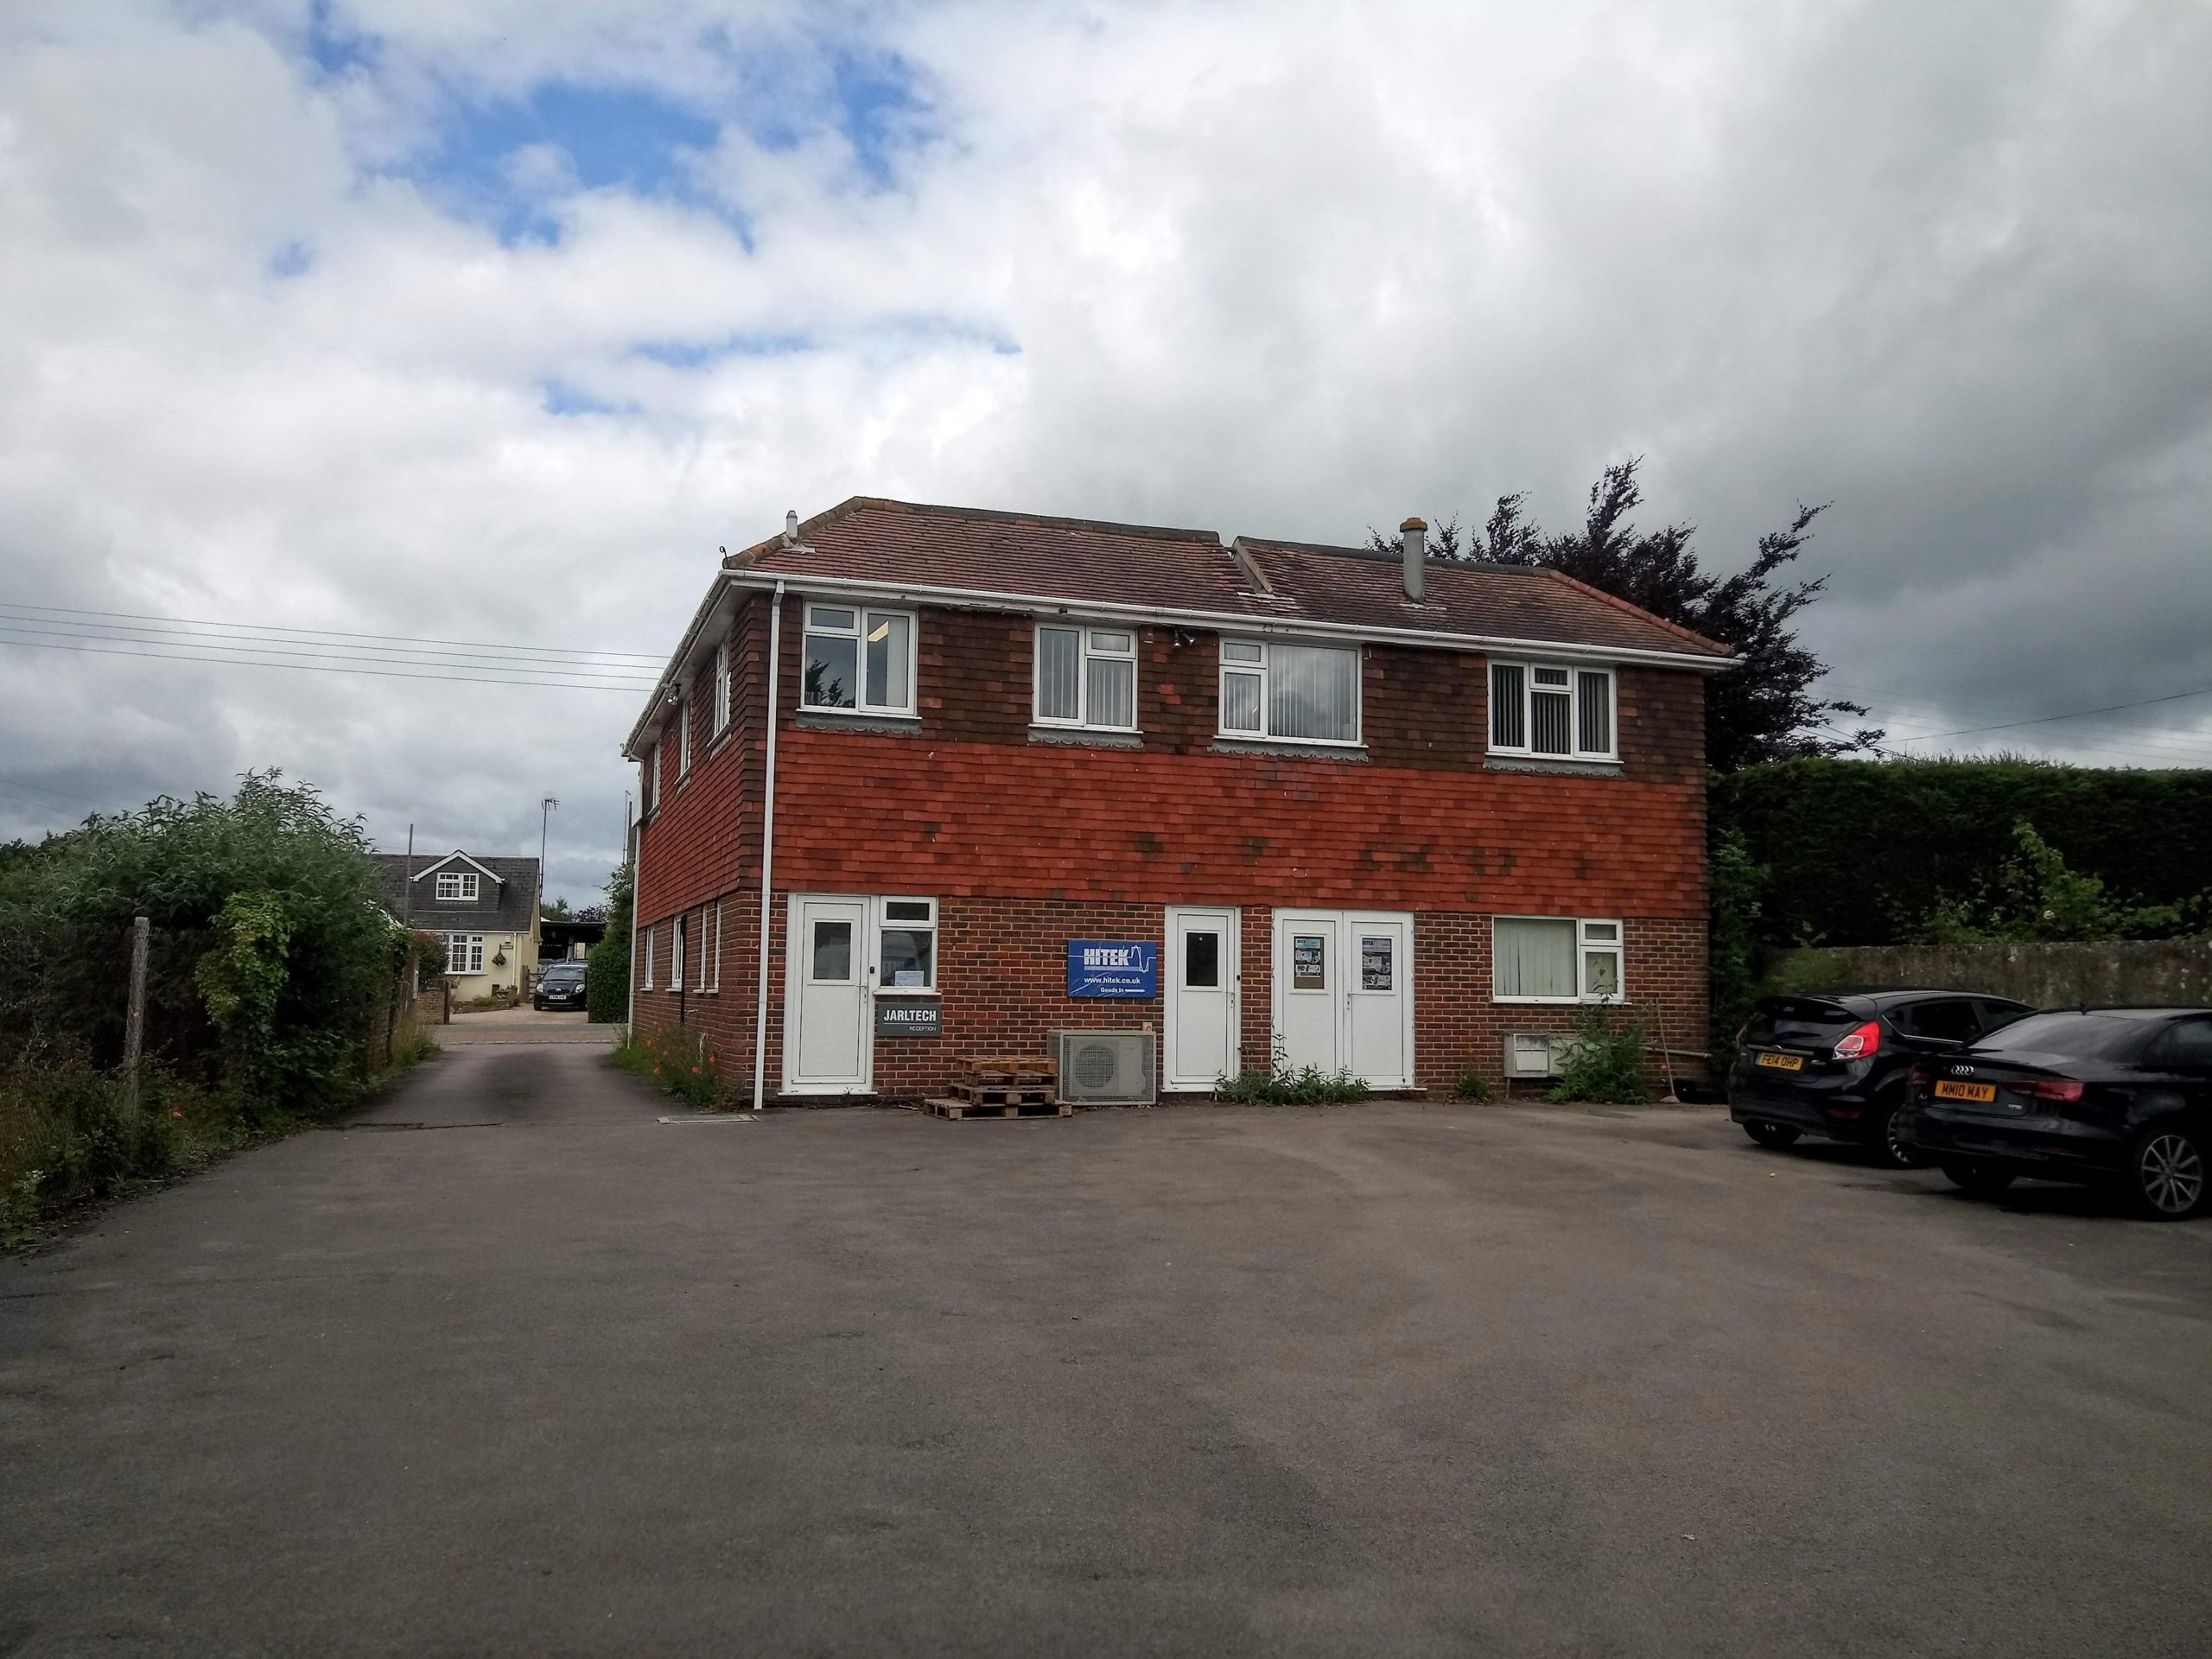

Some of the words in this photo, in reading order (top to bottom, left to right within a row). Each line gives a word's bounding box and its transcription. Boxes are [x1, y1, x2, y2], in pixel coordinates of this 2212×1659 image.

[1084, 948, 1129, 966] HITEK
[883, 1009, 937, 1021] JARLTECH
[1761, 1054, 1780, 1065] FE14
[1942, 1083, 1965, 1096] MM10
[1967, 1085, 1989, 1099] MAY
